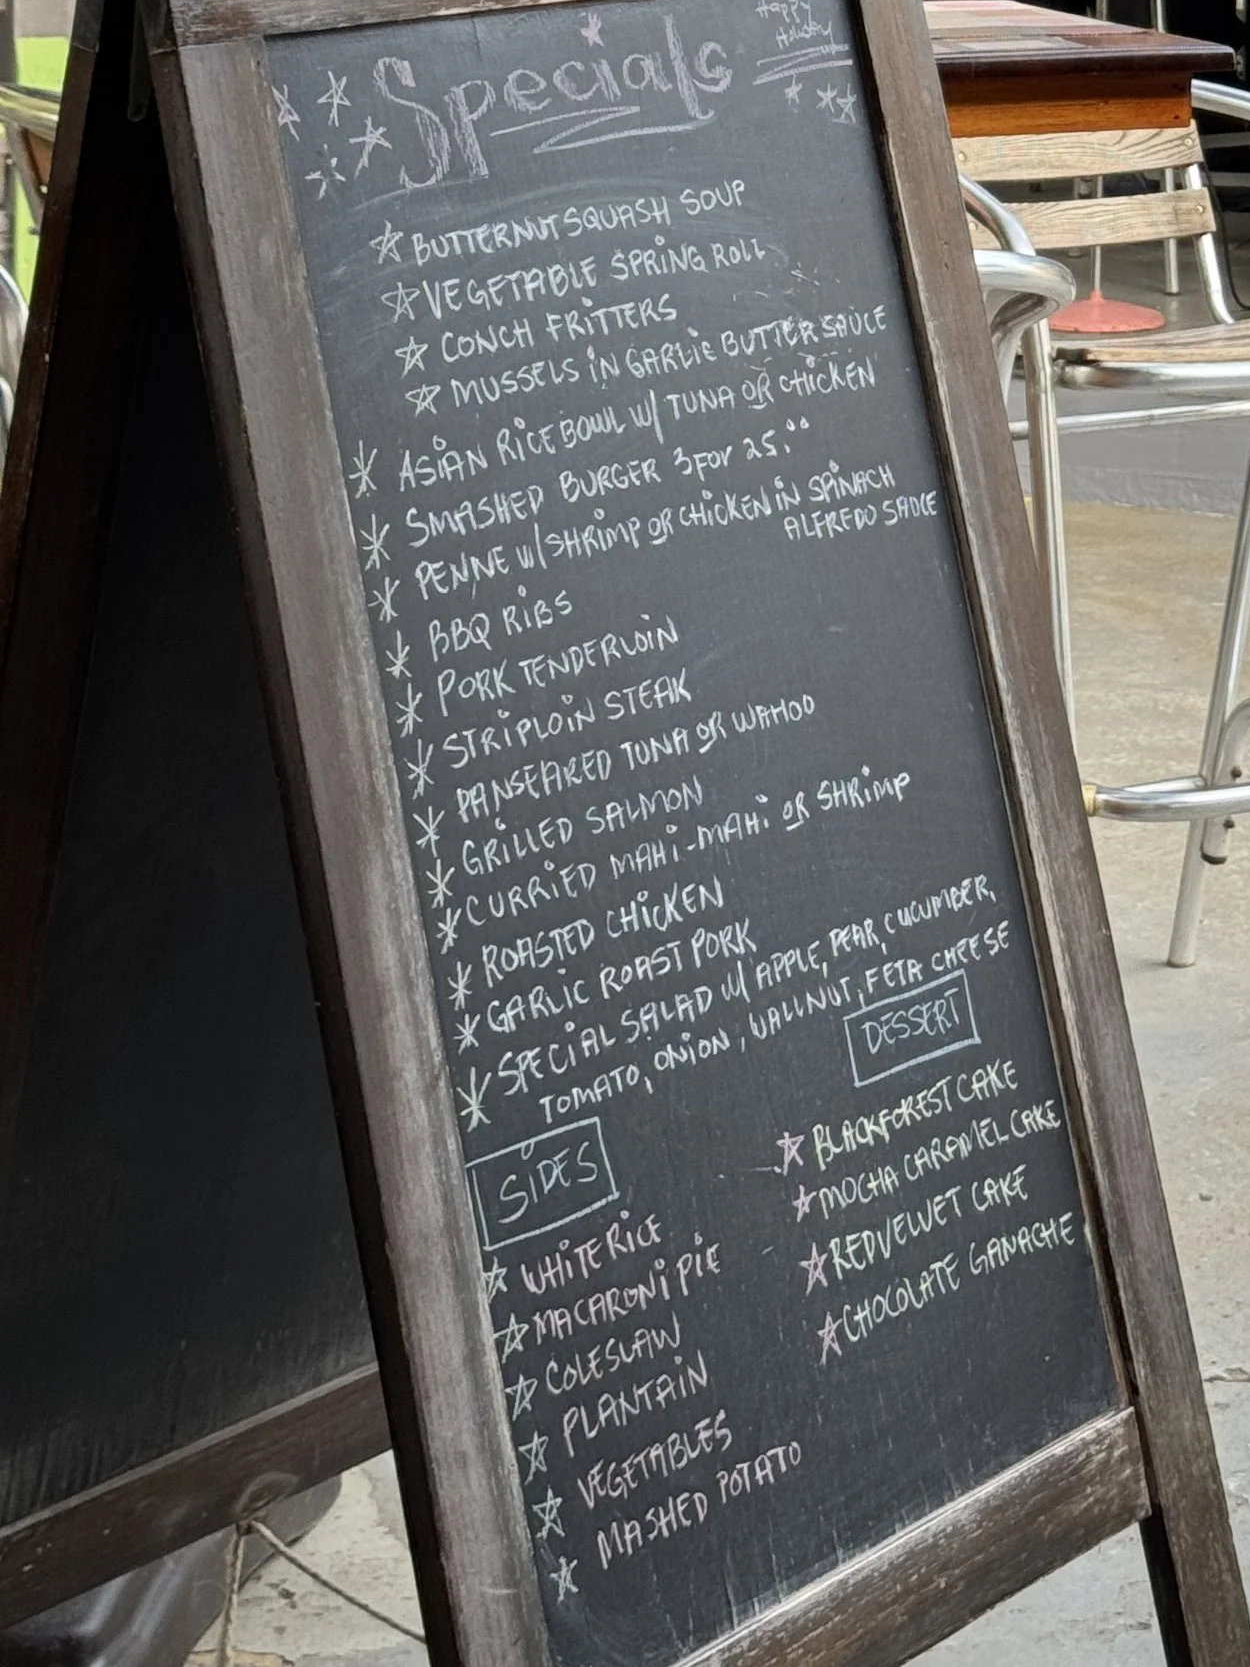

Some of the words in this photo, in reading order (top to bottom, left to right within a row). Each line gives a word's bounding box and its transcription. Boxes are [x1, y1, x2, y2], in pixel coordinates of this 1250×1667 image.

[411, 214, 559, 266] BUTTERNUT
[563, 196, 671, 236] SQUASH
[680, 180, 745, 215] SOUP
[423, 256, 597, 320] VEGETABLE
[441, 318, 535, 363] CONCH
[451, 358, 580, 407] MUSSELS
[721, 315, 819, 357] BUTTER
[822, 304, 887, 339] SAUCE
[560, 406, 626, 448] BOWL
[666, 385, 735, 421] TUNA
[742, 372, 775, 408] OR
[405, 485, 544, 548] SMASHED
[559, 458, 661, 502] BURGER
[784, 503, 877, 540] ALFREDO
[883, 490, 938, 527] SAUCE
[414, 545, 509, 600] PENNE
[648, 508, 674, 543] OR
[428, 612, 492, 662] BBQ
[438, 659, 516, 717] PORK
[603, 667, 692, 720] STEAK
[456, 749, 612, 823] PANSEARED
[620, 727, 689, 771] TUNA
[696, 711, 727, 746] OR
[731, 694, 815, 733] WAHOO
[585, 775, 703, 835] SALMON
[782, 791, 810, 826] OR
[482, 918, 595, 988] ROASTED
[600, 940, 683, 999] ROAST
[691, 917, 757, 968] PORK
[621, 985, 713, 1043] SALAD
[756, 940, 828, 991] APPLE,
[539, 1063, 654, 1123] TOMATO,
[865, 958, 923, 994] FETA
[931, 920, 1009, 972] CHEESE
[861, 987, 960, 1054] DESSERT
[956, 1058, 1018, 1102] CAKE
[819, 1165, 899, 1219] MOCHA
[904, 1116, 1009, 1182] CARAMEL
[1010, 1099, 1061, 1138] CAKE
[971, 1164, 1028, 1211] CAKE
[842, 1252, 960, 1342] CHOCOLATE
[969, 1212, 1077, 1275] GANACHE
[545, 1310, 683, 1395] COLESLAW
[578, 1408, 733, 1510] VEGETABLES
[597, 1491, 709, 1570] MASHED
[717, 1441, 802, 1504] POTATO
